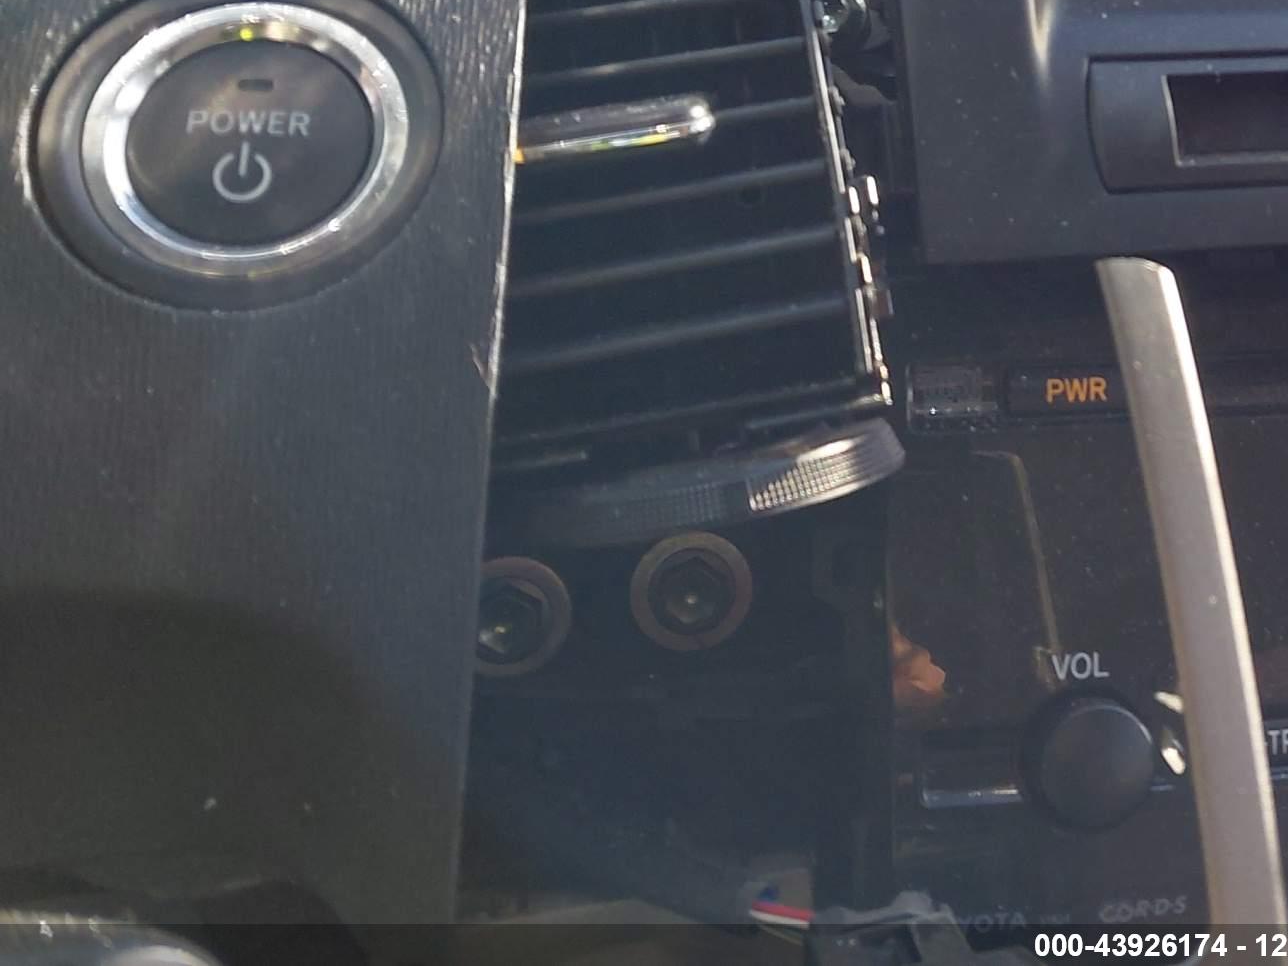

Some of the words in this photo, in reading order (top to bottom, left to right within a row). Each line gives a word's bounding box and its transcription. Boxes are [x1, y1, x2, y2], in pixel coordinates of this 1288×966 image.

[186, 109, 311, 136] POWER
[1045, 376, 1108, 403] PWR
[1051, 651, 1110, 681] VOL
